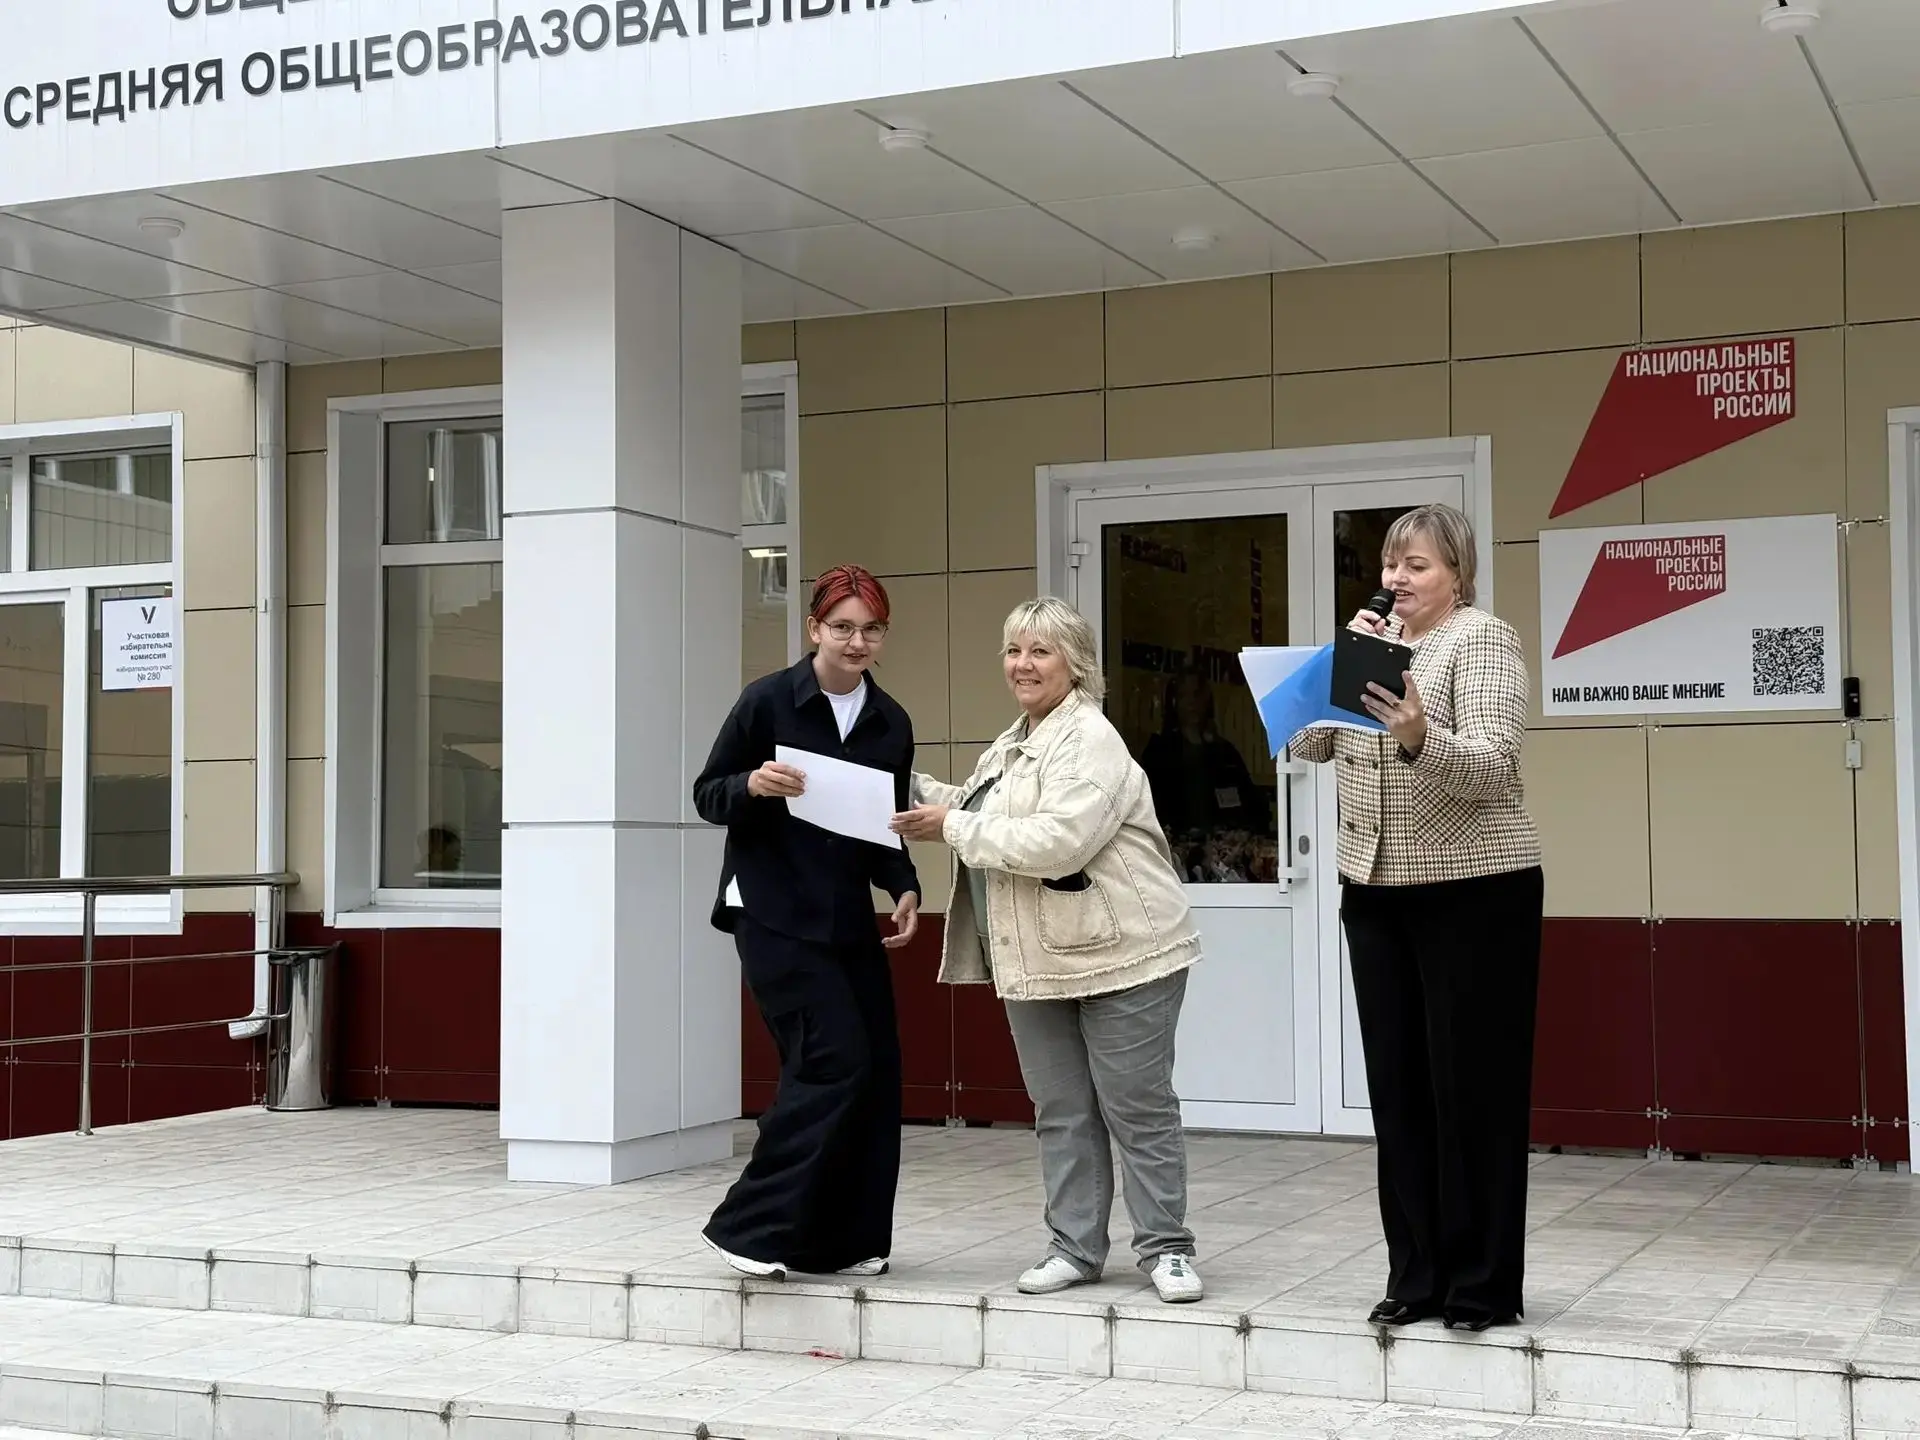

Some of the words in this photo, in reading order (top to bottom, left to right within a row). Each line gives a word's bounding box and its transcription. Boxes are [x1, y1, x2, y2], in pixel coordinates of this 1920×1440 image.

[3, 57, 225, 129] СРЕДНЯЯ
[1625, 341, 1791, 377] НАЦИОНАЛЬНЫЕ
[1695, 368, 1791, 397] ПРОЕКТЫ
[1713, 391, 1791, 420] РОССИИ
[1605, 536, 1723, 560] НАЦИОНАЛЬНЫЕ
[1655, 554, 1723, 575] ПРОЕКТЫ
[1667, 573, 1723, 592] РОССИИ
[127, 632, 169, 640] Участковая
[130, 652, 166, 660] комиссия
[1552, 687, 1580, 703] НАМ
[1583, 685, 1630, 702] ВАЖНО
[1632, 684, 1670, 700] ВАШЕ
[1672, 682, 1726, 699] МНЕНИЕ
